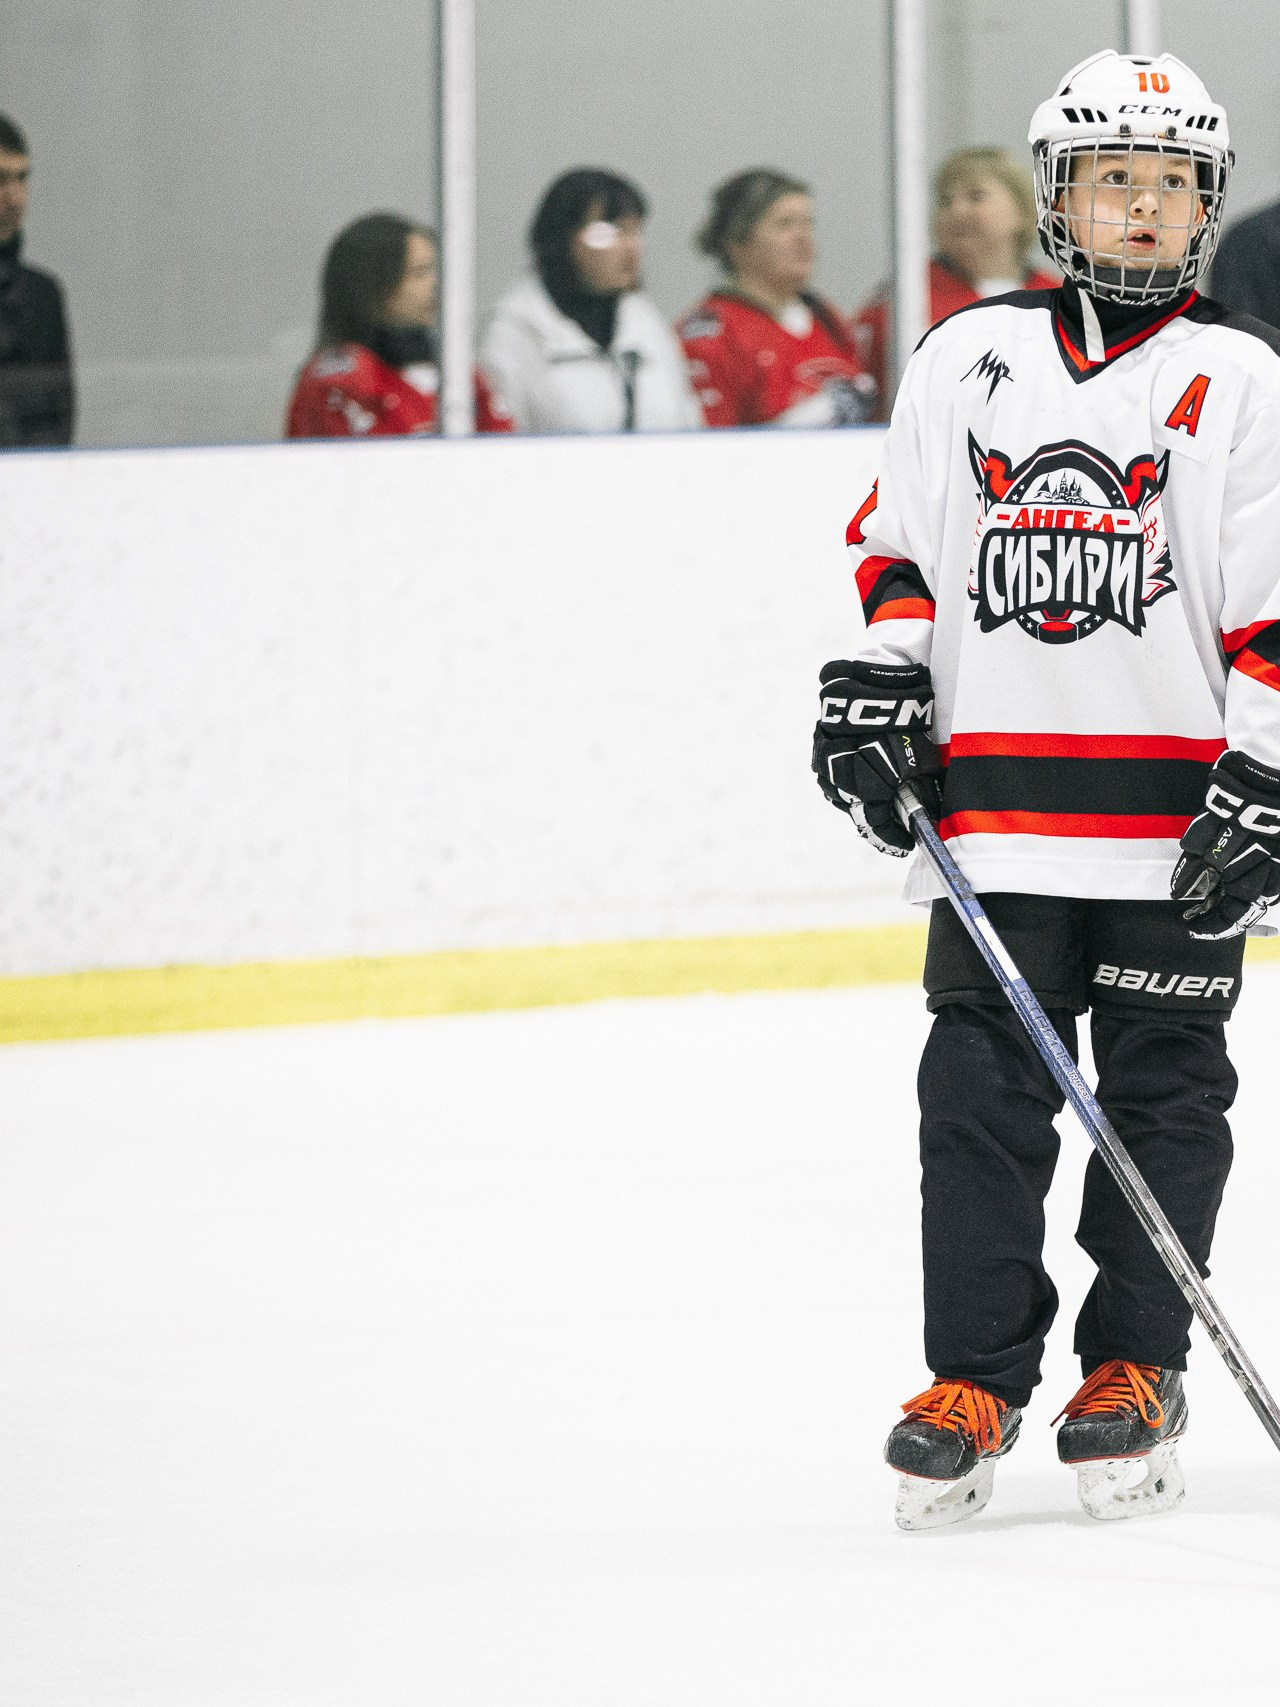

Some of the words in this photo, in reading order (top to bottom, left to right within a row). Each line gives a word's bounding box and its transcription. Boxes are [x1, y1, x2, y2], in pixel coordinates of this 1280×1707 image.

[1133, 71, 1171, 94] 10
[1118, 104, 1183, 117] CCM
[1164, 373, 1212, 438] A
[985, 535, 1139, 625] СИБИРИ
[821, 696, 934, 726] CCM
